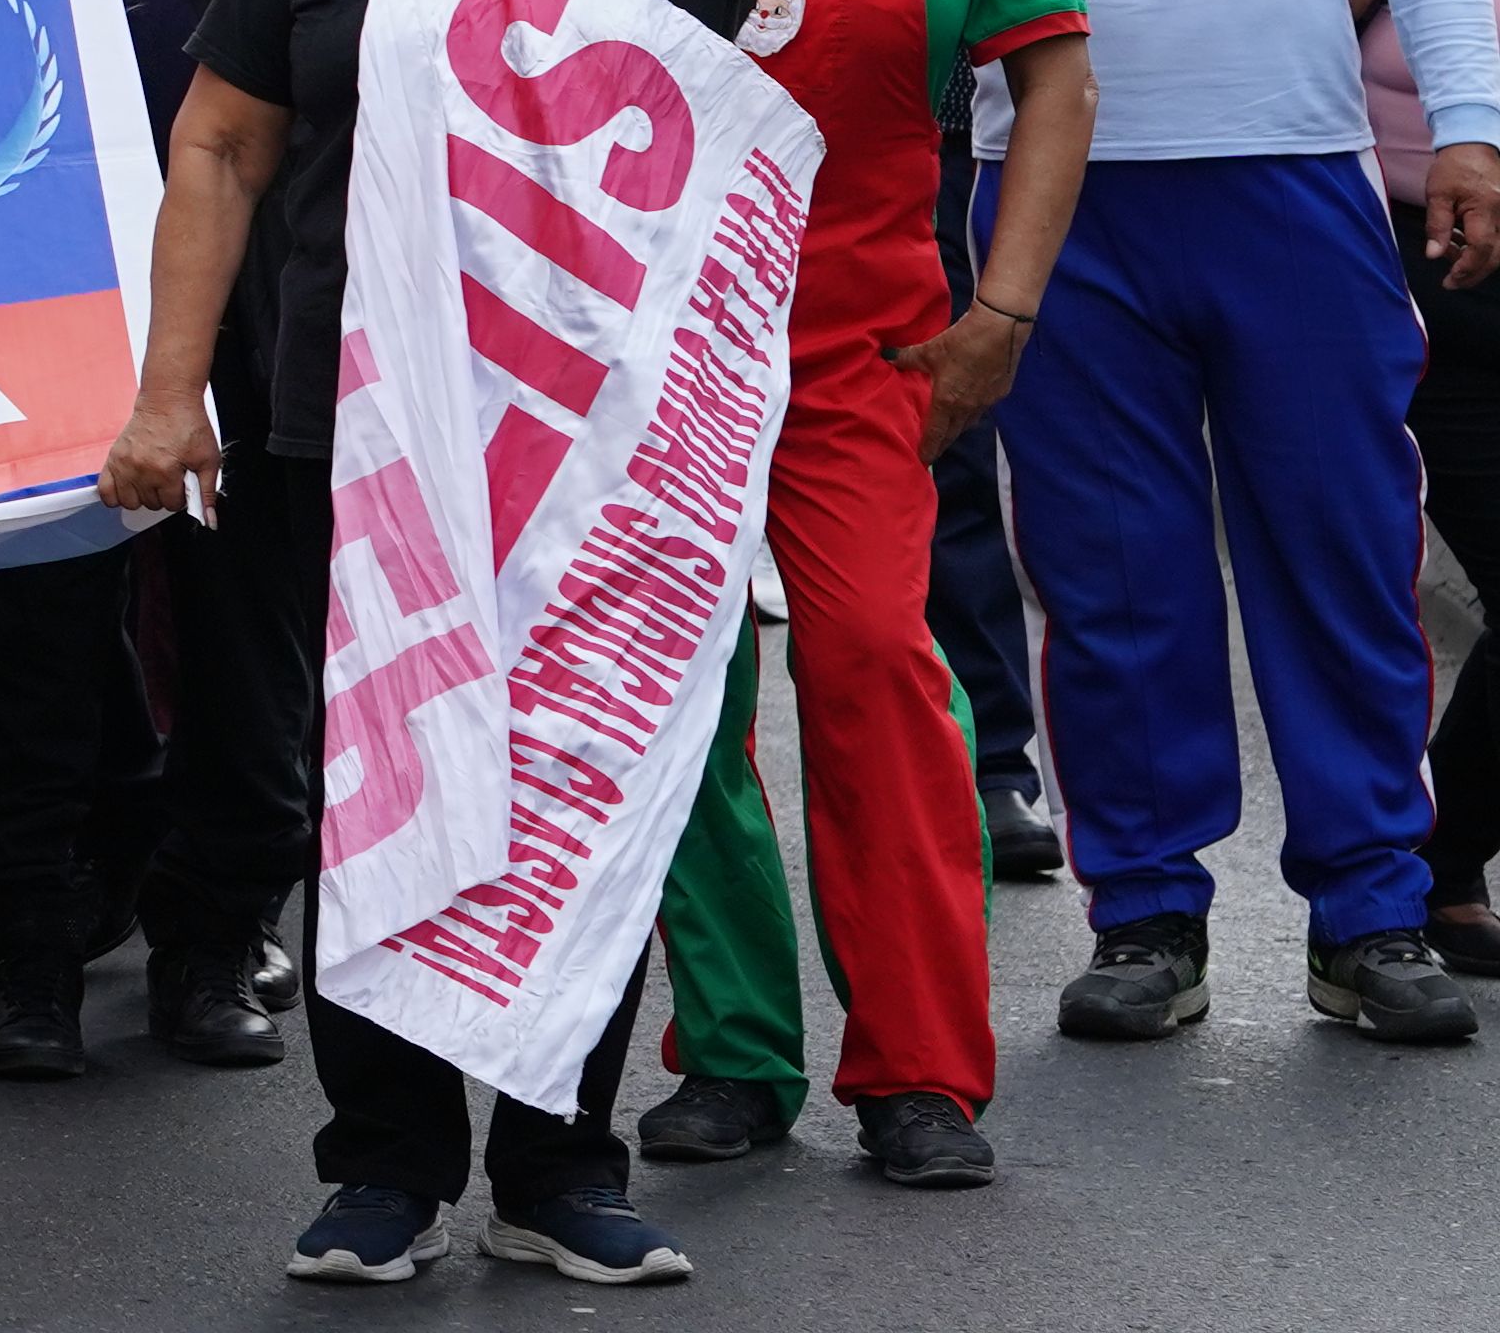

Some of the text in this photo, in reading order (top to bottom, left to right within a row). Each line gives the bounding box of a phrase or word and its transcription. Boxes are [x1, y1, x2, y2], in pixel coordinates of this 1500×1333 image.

[687, 253, 774, 370] LA
[625, 326, 766, 546] UNIDAD
[510, 500, 729, 758] SINDICAL
